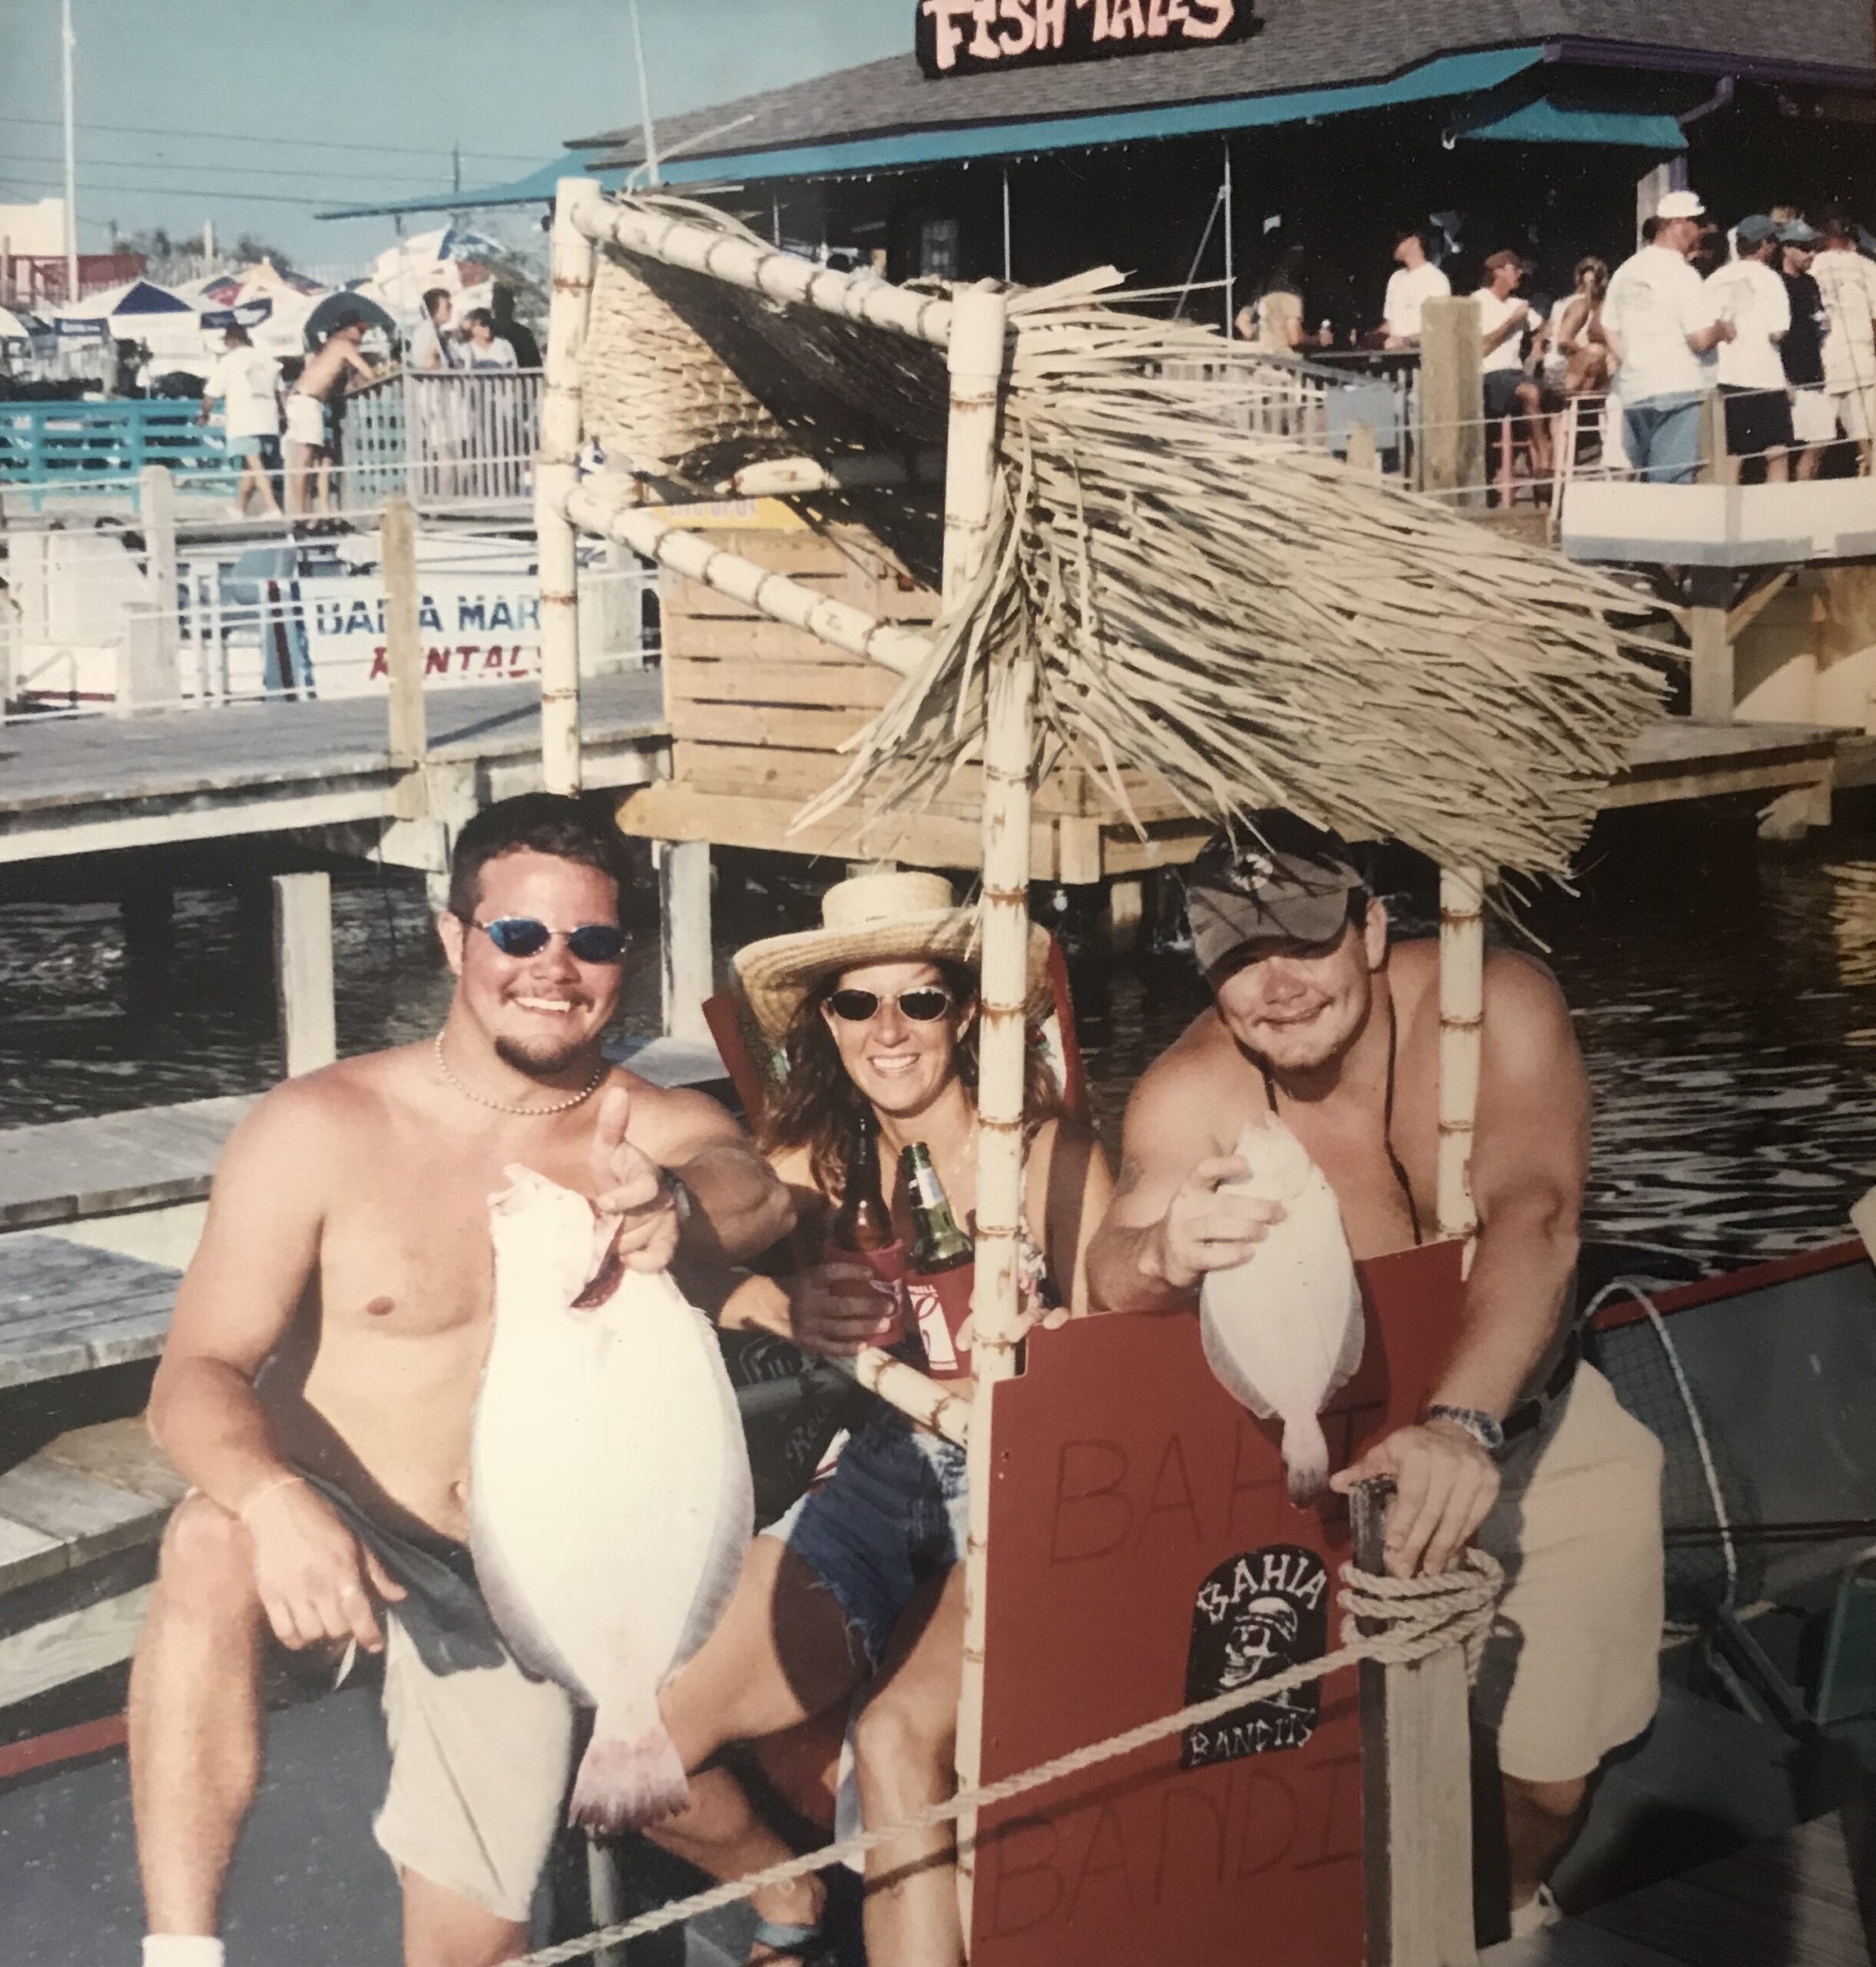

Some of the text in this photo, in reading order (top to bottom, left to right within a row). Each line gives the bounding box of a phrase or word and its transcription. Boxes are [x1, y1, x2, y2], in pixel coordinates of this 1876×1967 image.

[923, 0, 1066, 70] FISH
[370, 644, 542, 681] RNTAL
[1197, 1553, 1327, 1624] BAHIA
